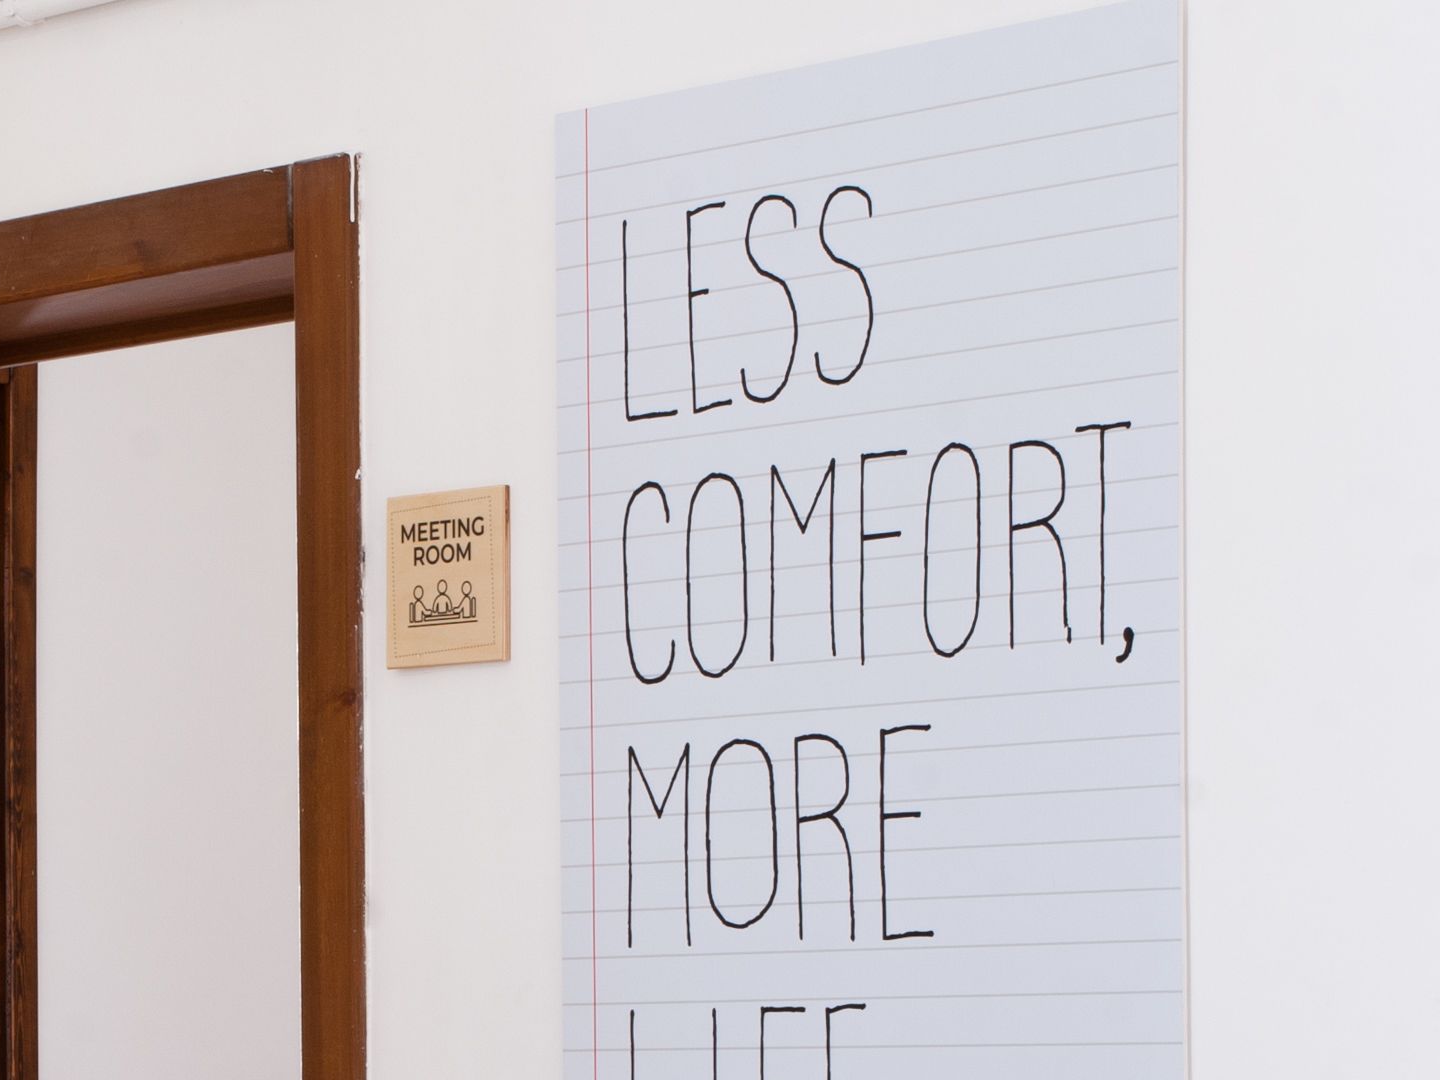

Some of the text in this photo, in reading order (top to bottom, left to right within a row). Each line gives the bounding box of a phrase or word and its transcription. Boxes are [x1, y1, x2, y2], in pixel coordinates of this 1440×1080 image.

[622, 185, 873, 422] LESS
[400, 516, 485, 543] MEETING
[413, 541, 471, 566] ROOM
[623, 420, 1135, 685] COMFORT,
[627, 723, 934, 949] MORE
